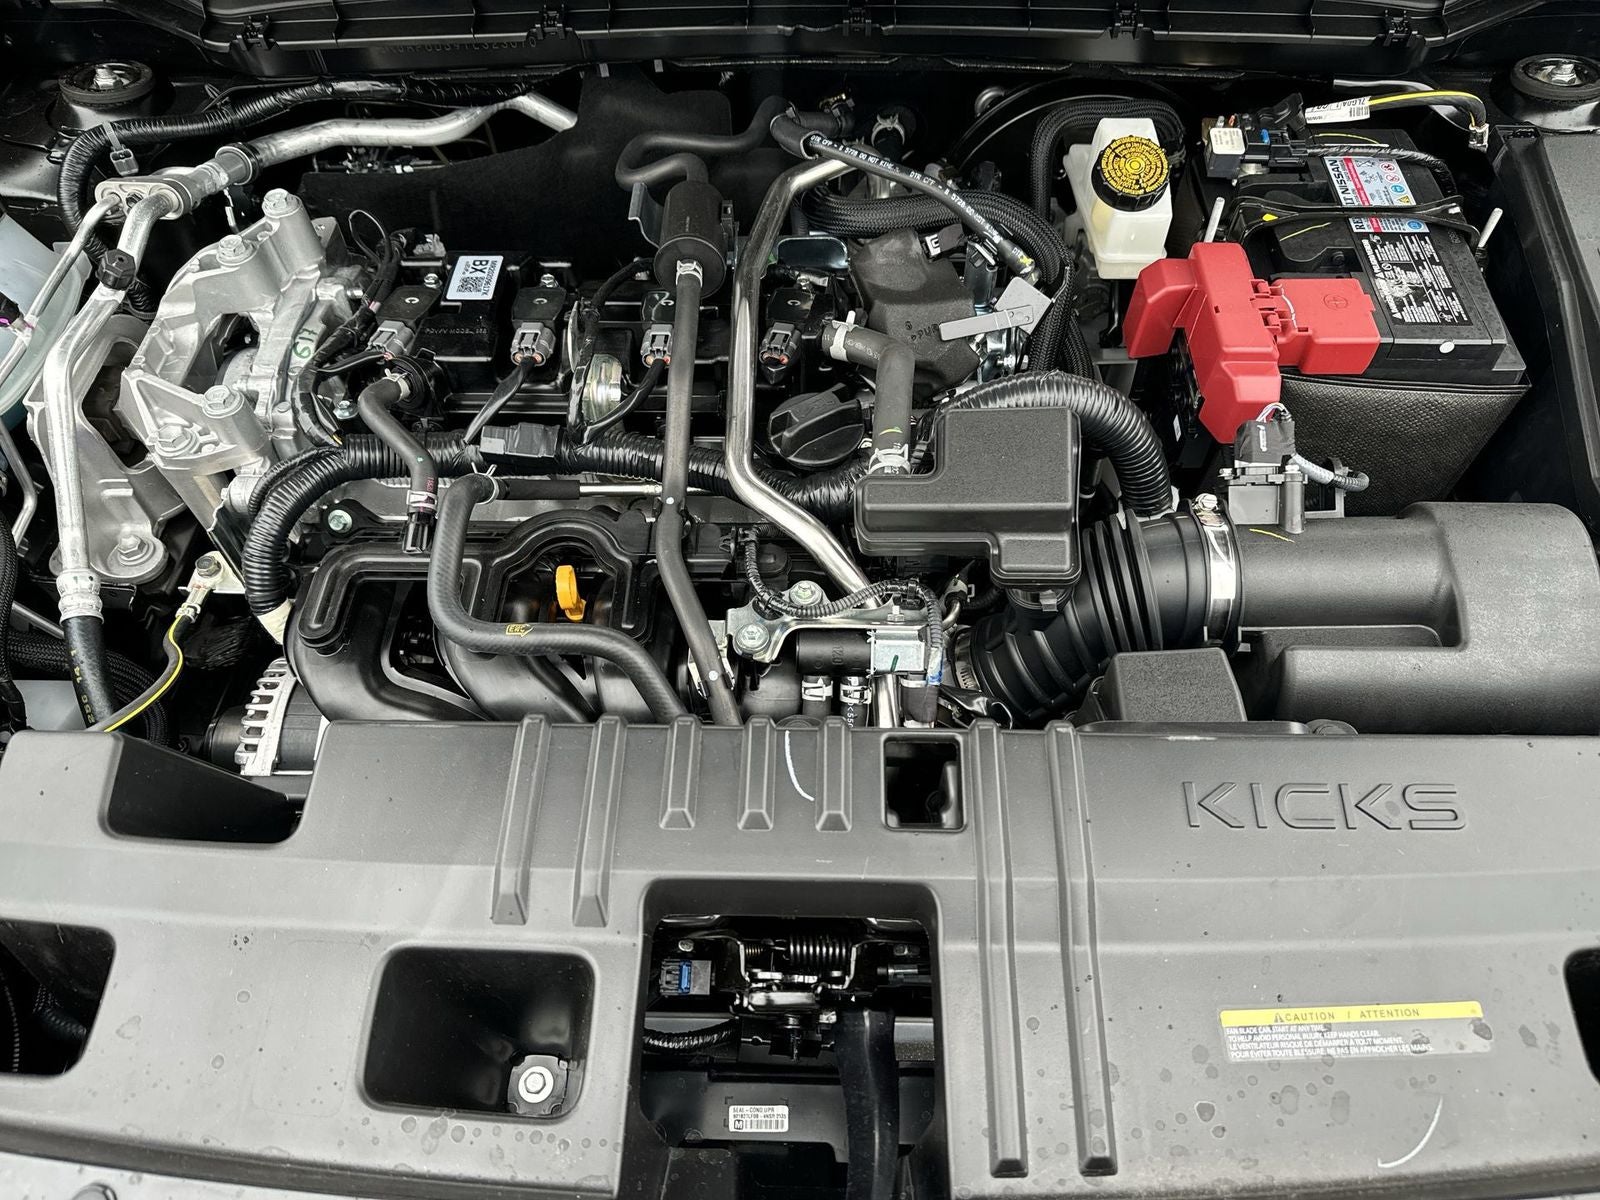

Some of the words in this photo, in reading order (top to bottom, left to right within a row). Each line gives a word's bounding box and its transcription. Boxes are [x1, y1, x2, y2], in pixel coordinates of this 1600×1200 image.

[1328, 158, 1351, 195] NISSAN
[469, 259, 490, 274] BX
[1182, 781, 1466, 830] KICKS
[1285, 1011, 1335, 1022] CAUTION
[1360, 1008, 1420, 1019] ATTENTION
